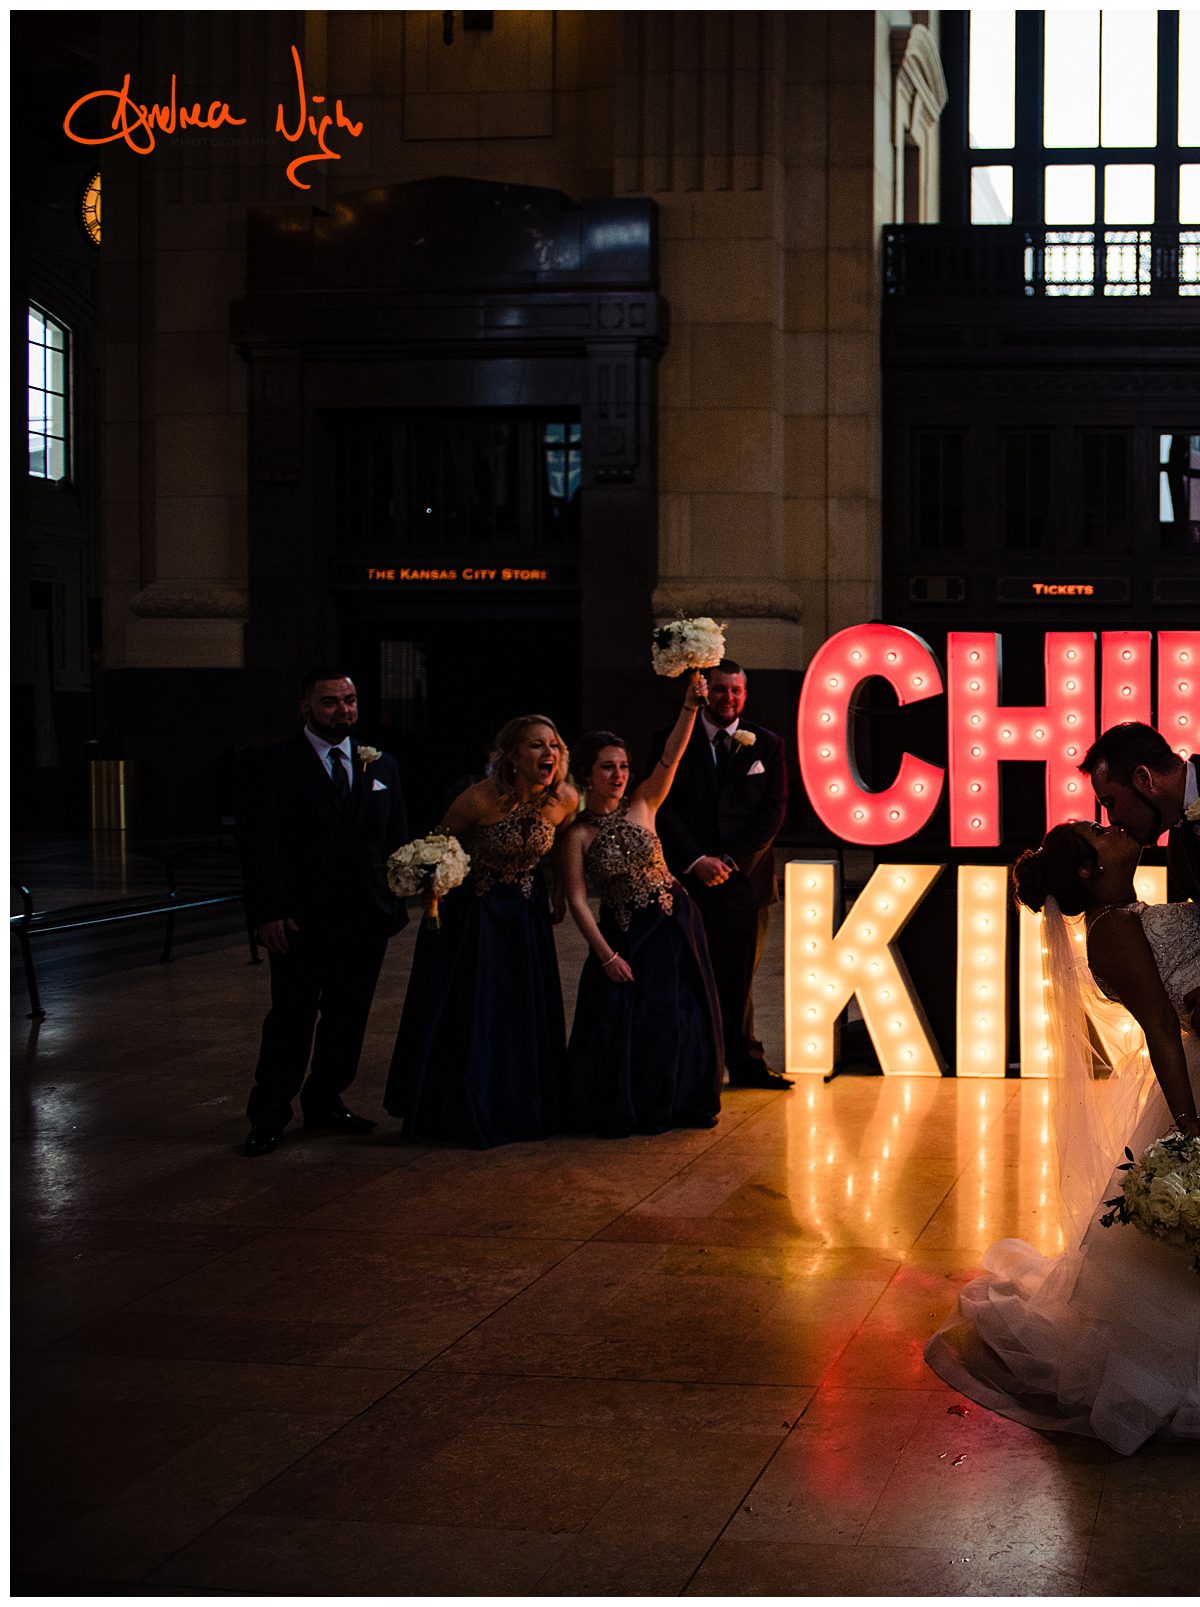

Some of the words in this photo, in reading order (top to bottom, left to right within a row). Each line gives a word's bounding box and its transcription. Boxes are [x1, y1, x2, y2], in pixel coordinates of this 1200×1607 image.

[400, 568, 457, 581] KANSAS
[462, 568, 497, 581] CITY
[1032, 582, 1095, 596] TICKETS
